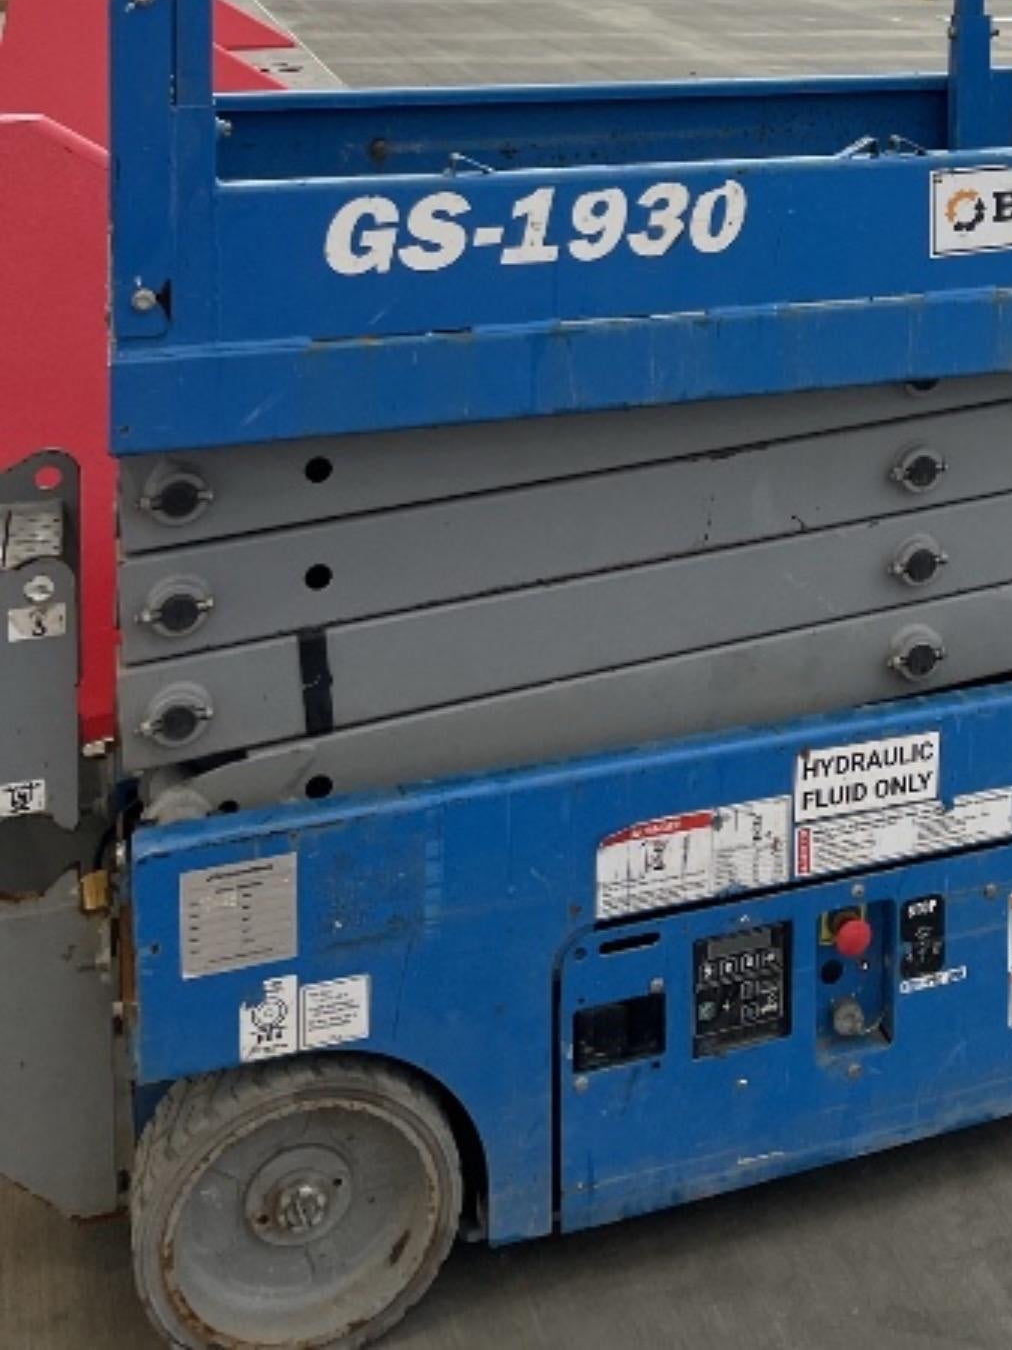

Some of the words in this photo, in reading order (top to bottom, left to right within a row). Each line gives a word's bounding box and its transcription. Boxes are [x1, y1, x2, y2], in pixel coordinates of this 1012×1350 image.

[324, 179, 747, 276] GS-1930
[802, 740, 935, 781] HYDRAULIC
[802, 782, 868, 811] FLUID
[875, 771, 933, 799] ONLY
